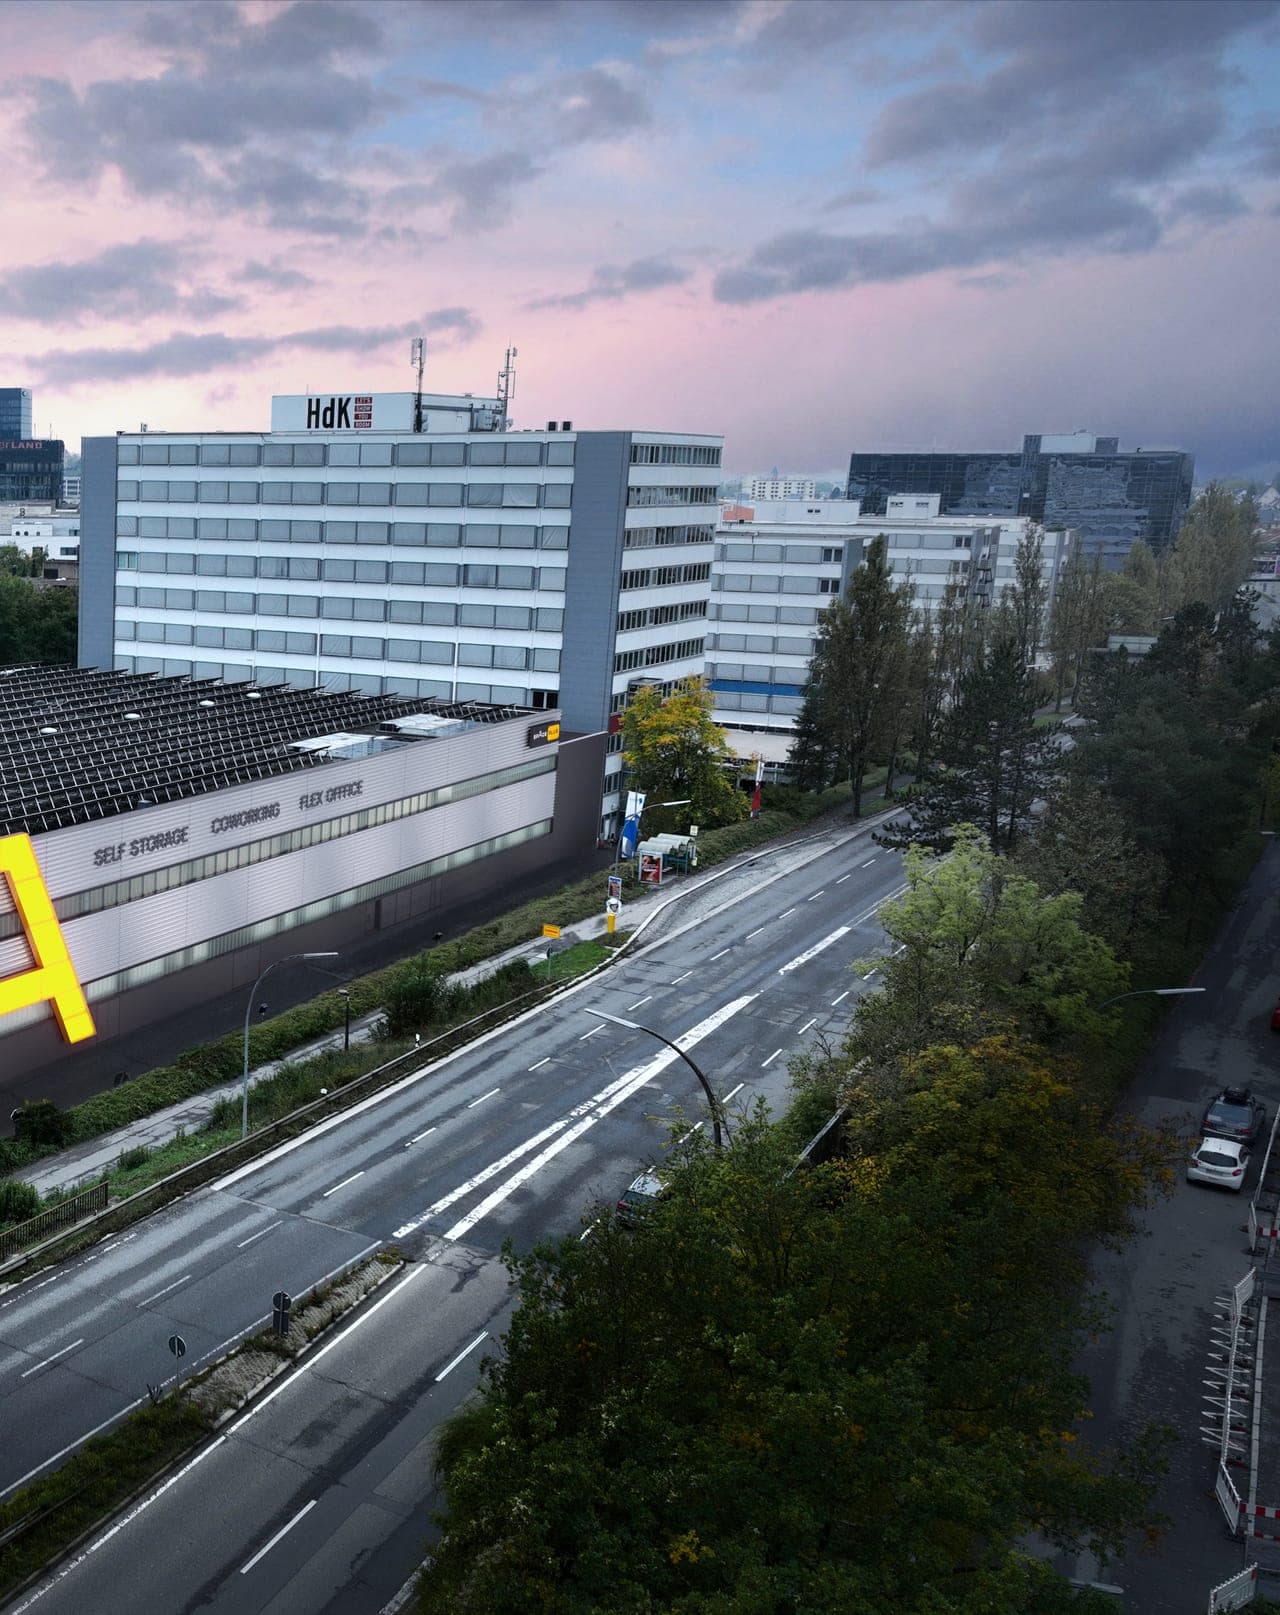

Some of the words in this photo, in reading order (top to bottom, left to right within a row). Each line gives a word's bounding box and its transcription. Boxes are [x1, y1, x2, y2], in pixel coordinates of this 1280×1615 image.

[307, 397, 351, 429] HdK
[299, 790, 324, 811] FLEX
[325, 780, 364, 803] OFFICE
[211, 802, 281, 834] COWORKING
[94, 843, 126, 866] SELF
[129, 826, 189, 856] STORAGE
